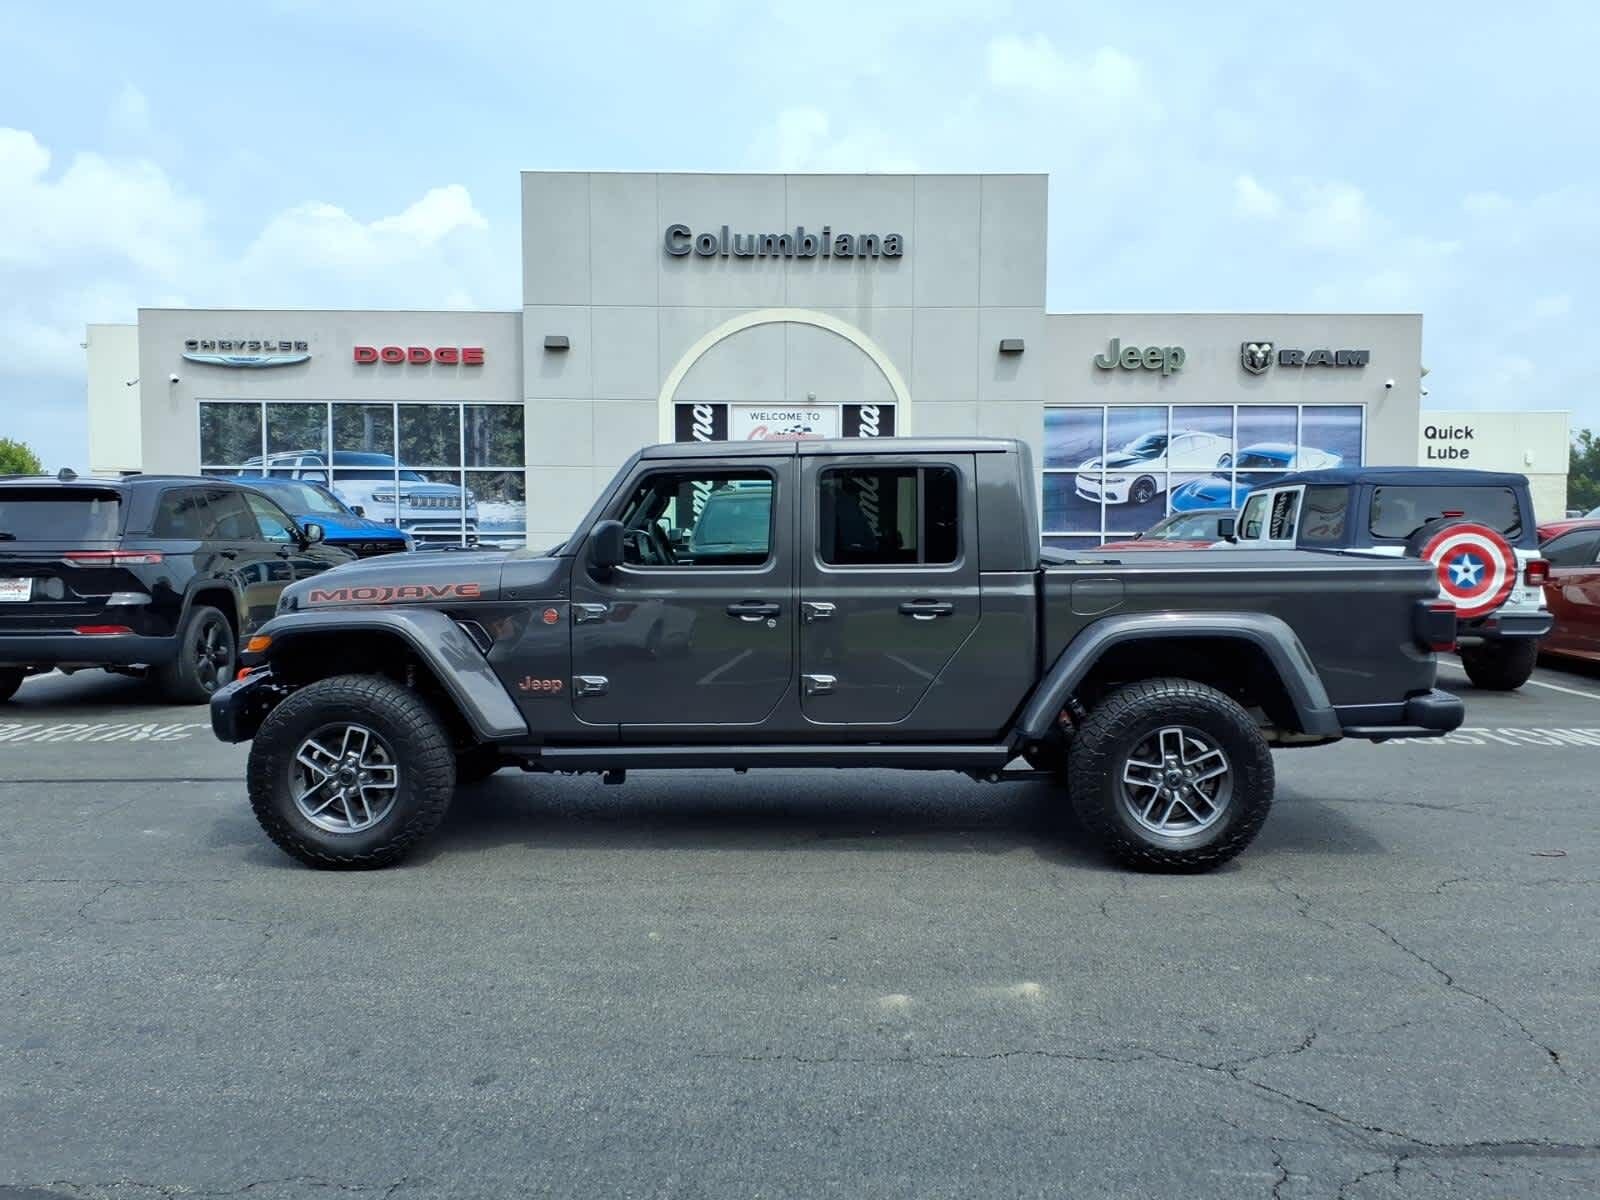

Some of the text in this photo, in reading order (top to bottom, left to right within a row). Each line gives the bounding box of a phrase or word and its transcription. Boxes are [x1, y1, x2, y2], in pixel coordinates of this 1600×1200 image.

[664, 223, 904, 257] Columbiana
[184, 339, 309, 352] CHRYSLER
[353, 345, 485, 366] DODGE
[1094, 337, 1186, 377] Jeep
[1278, 349, 1371, 368] RAM
[749, 412, 821, 421] WELCOME TO
[1424, 425, 1474, 440] Quick
[1427, 445, 1470, 459] Lube
[309, 583, 481, 603] MOJAVE
[518, 676, 563, 694] Jeep
